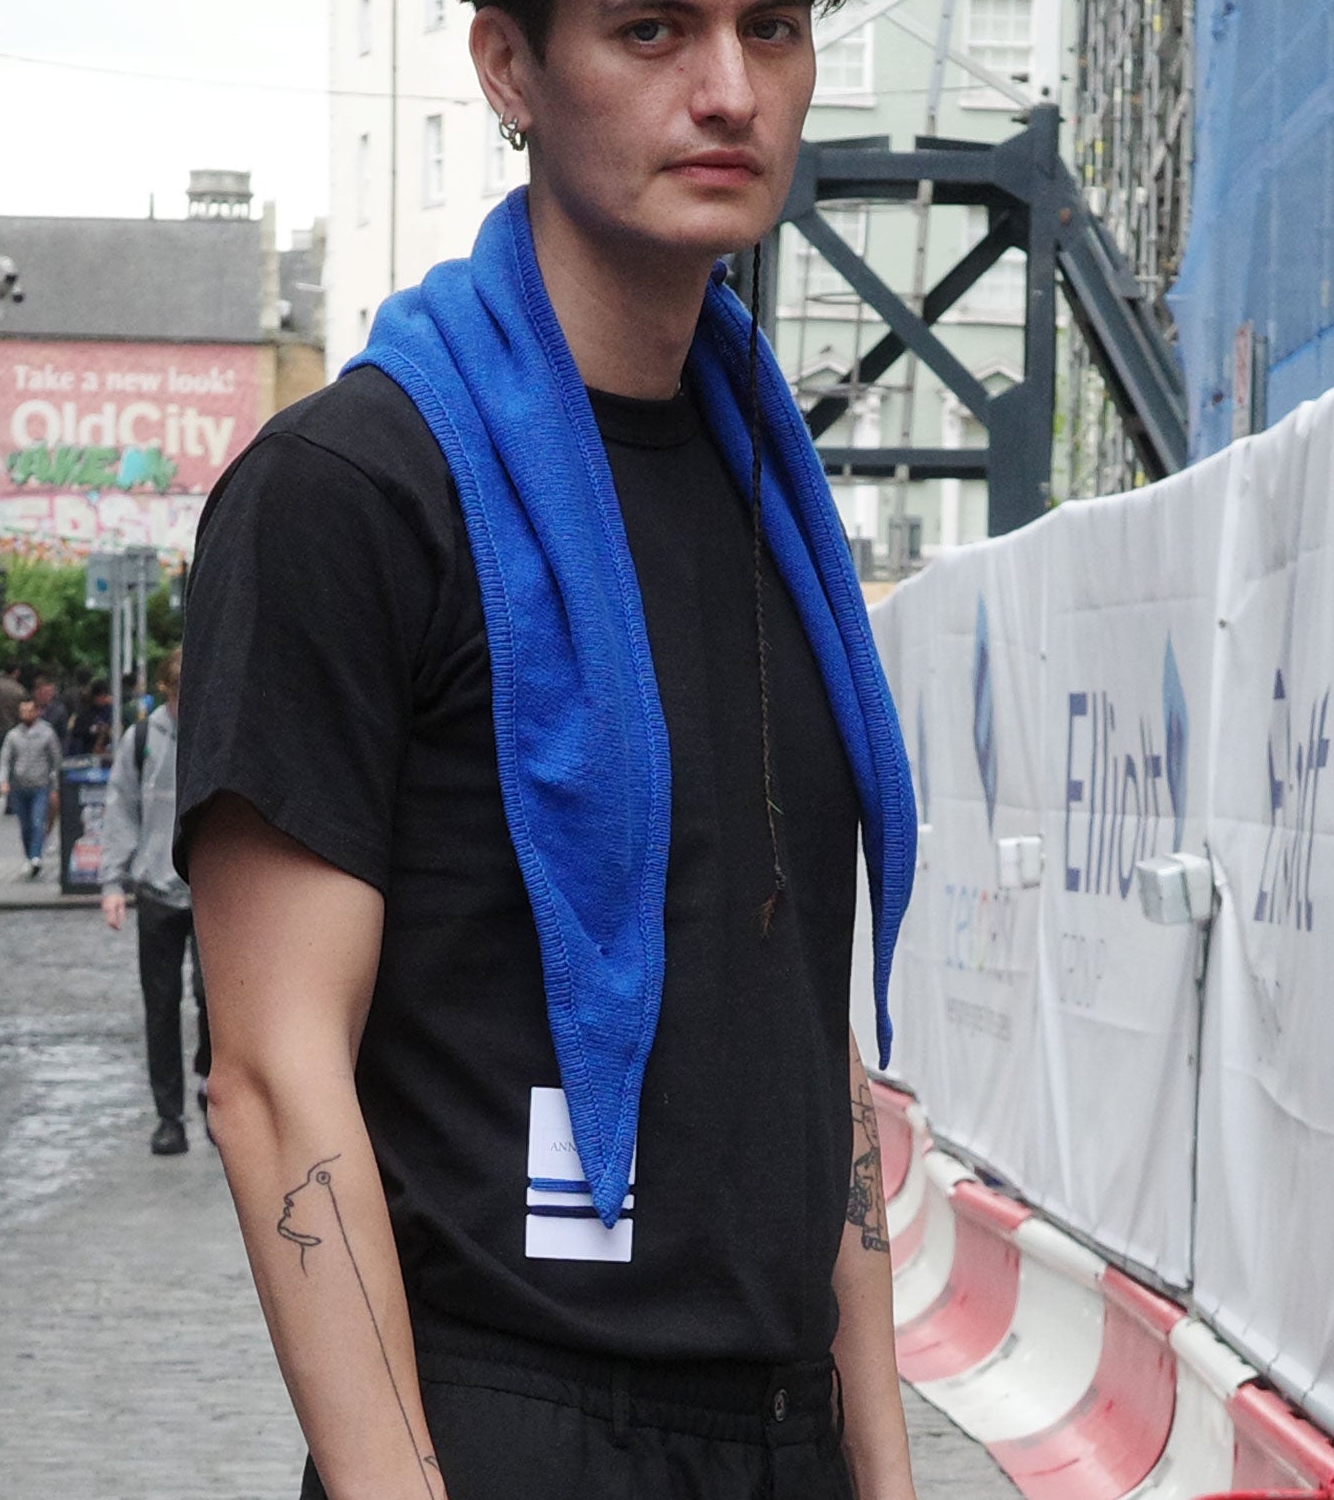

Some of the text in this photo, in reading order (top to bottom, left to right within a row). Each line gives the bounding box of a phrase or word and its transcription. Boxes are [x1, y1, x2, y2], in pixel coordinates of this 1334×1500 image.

[13, 365, 74, 391] Take
[81, 372, 99, 392] a
[105, 372, 163, 392] new
